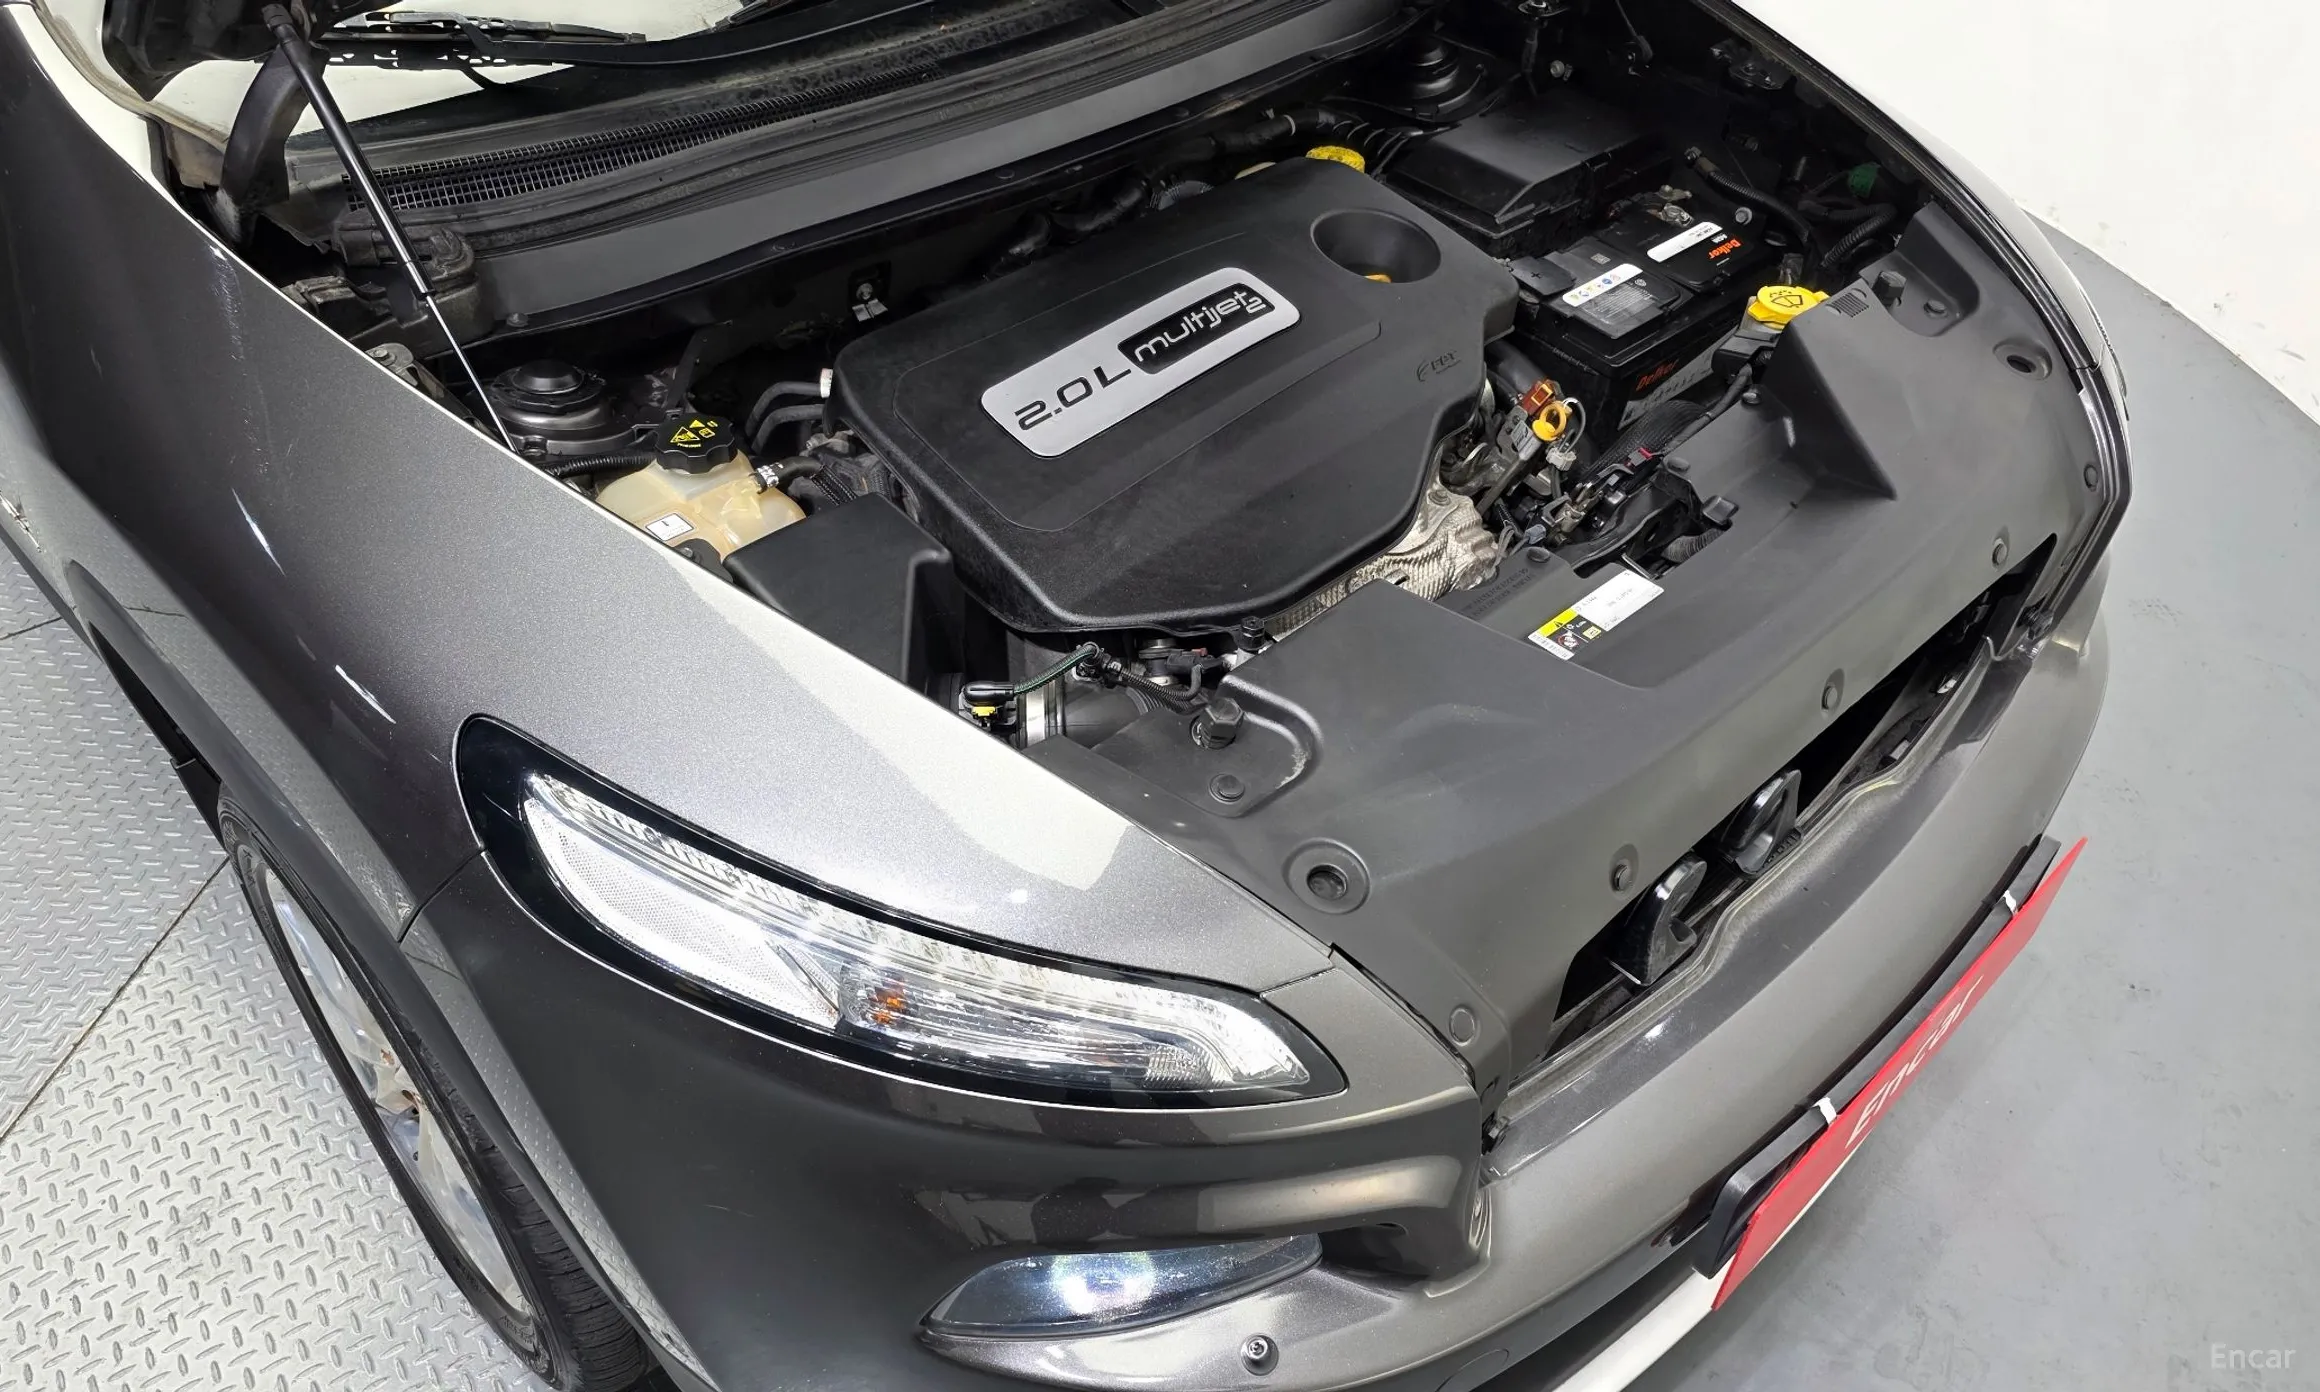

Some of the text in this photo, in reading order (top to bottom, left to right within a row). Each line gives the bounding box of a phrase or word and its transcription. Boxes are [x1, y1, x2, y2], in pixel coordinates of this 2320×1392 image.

[1708, 239, 1741, 259] Delkor
[1015, 366, 1131, 430] 2.0L
[1845, 975, 1983, 1147] Encar
